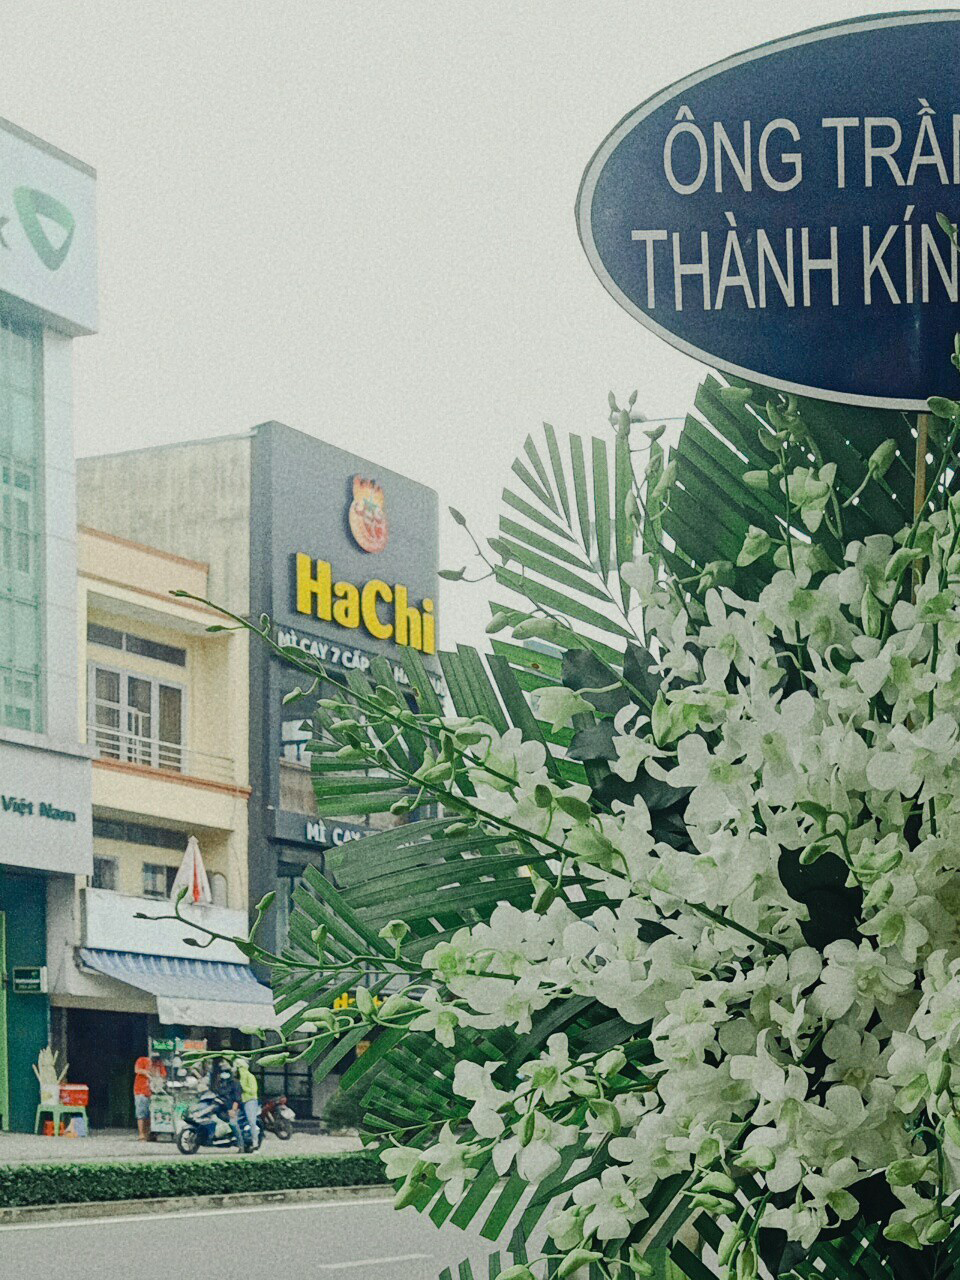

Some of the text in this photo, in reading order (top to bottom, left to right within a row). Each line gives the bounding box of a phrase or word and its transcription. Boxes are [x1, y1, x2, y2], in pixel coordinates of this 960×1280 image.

[663, 104, 803, 198] ÔNG
[631, 211, 840, 312] THÀNH
[295, 551, 436, 655] HaChi
[299, 636, 329, 660] CAY
[331, 646, 341, 664] 7
[1, 795, 76, 822] Việt Nam
[306, 818, 327, 844] MÌ
